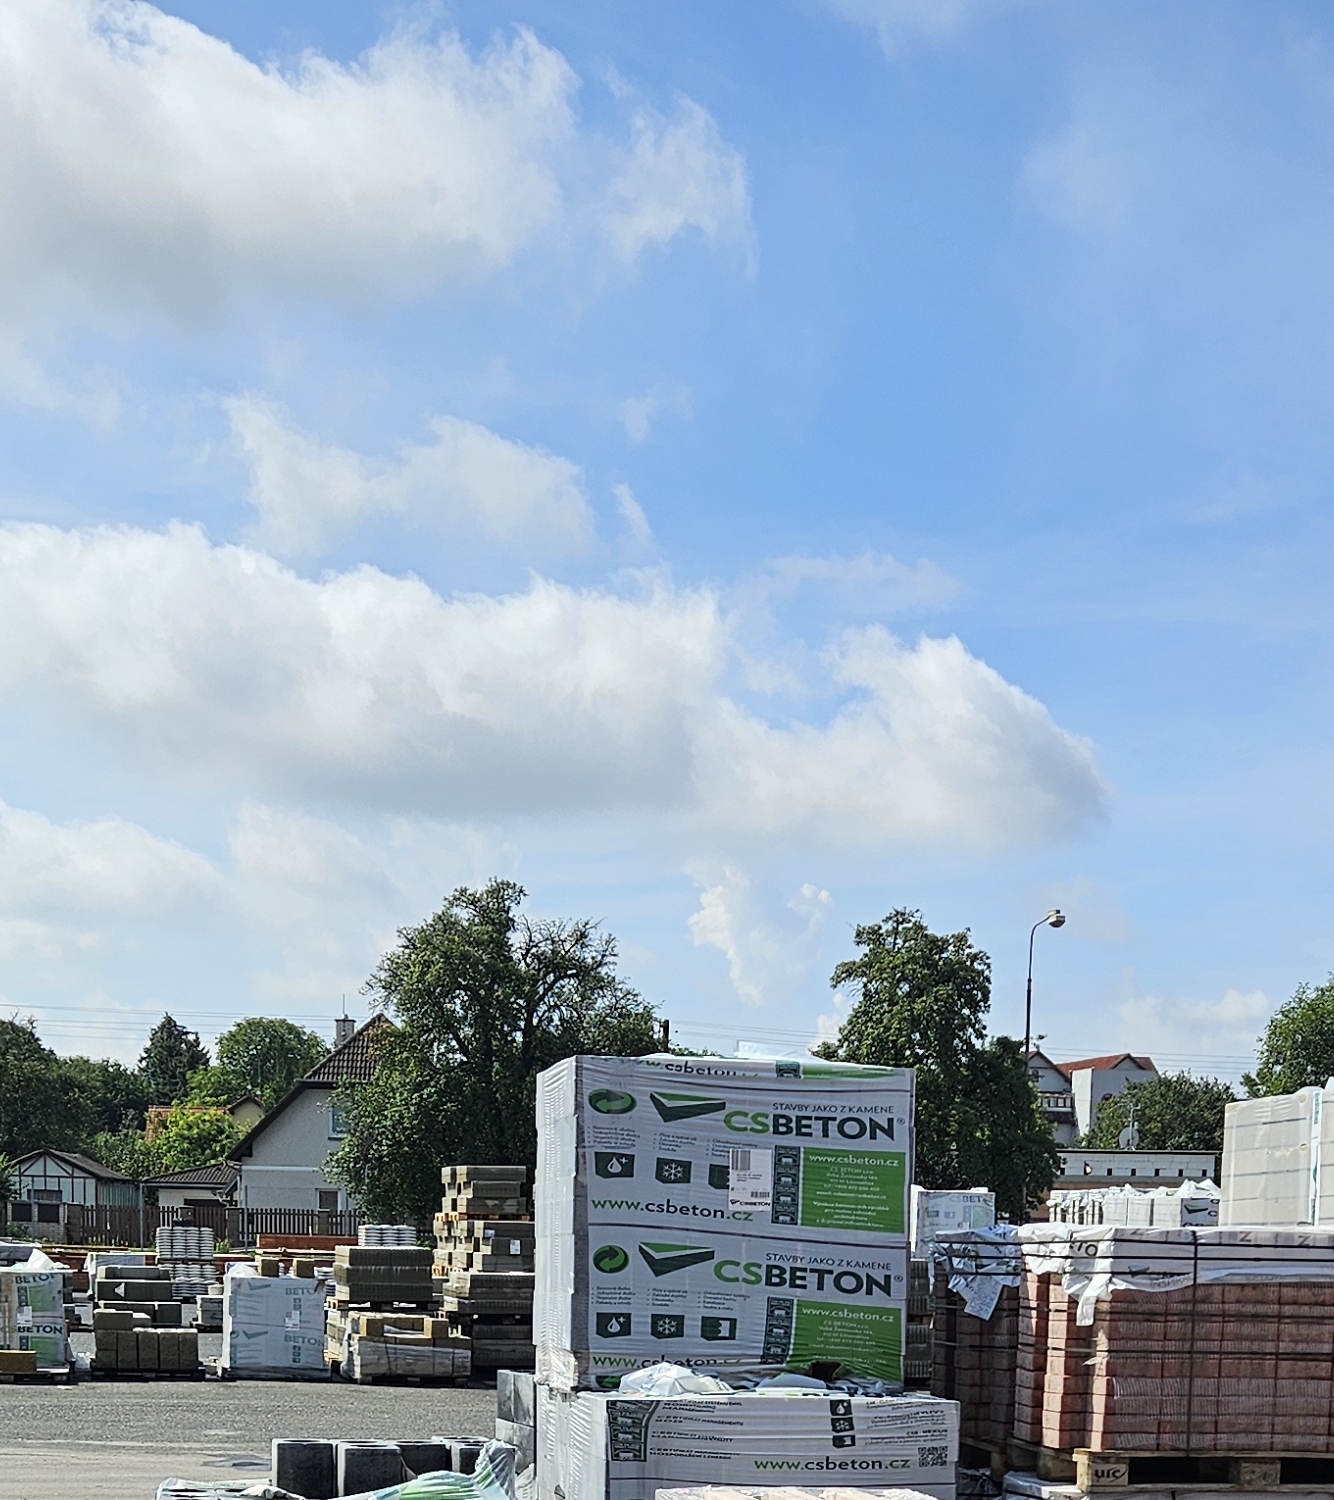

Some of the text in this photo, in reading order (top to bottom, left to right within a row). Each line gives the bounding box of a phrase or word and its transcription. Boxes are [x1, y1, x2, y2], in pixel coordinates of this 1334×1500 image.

[772, 1103, 894, 1115] STAVBY JAKO Z KAMENE
[809, 1154, 899, 1168] www.csbeton.cz
[591, 1199, 754, 1222] www.csbeton.cz
[765, 1252, 892, 1271] STAVBY JAKO Z KAMENE
[802, 1307, 895, 1323] www.csbeton.cz
[754, 1456, 910, 1471] www.csbeton.cz
